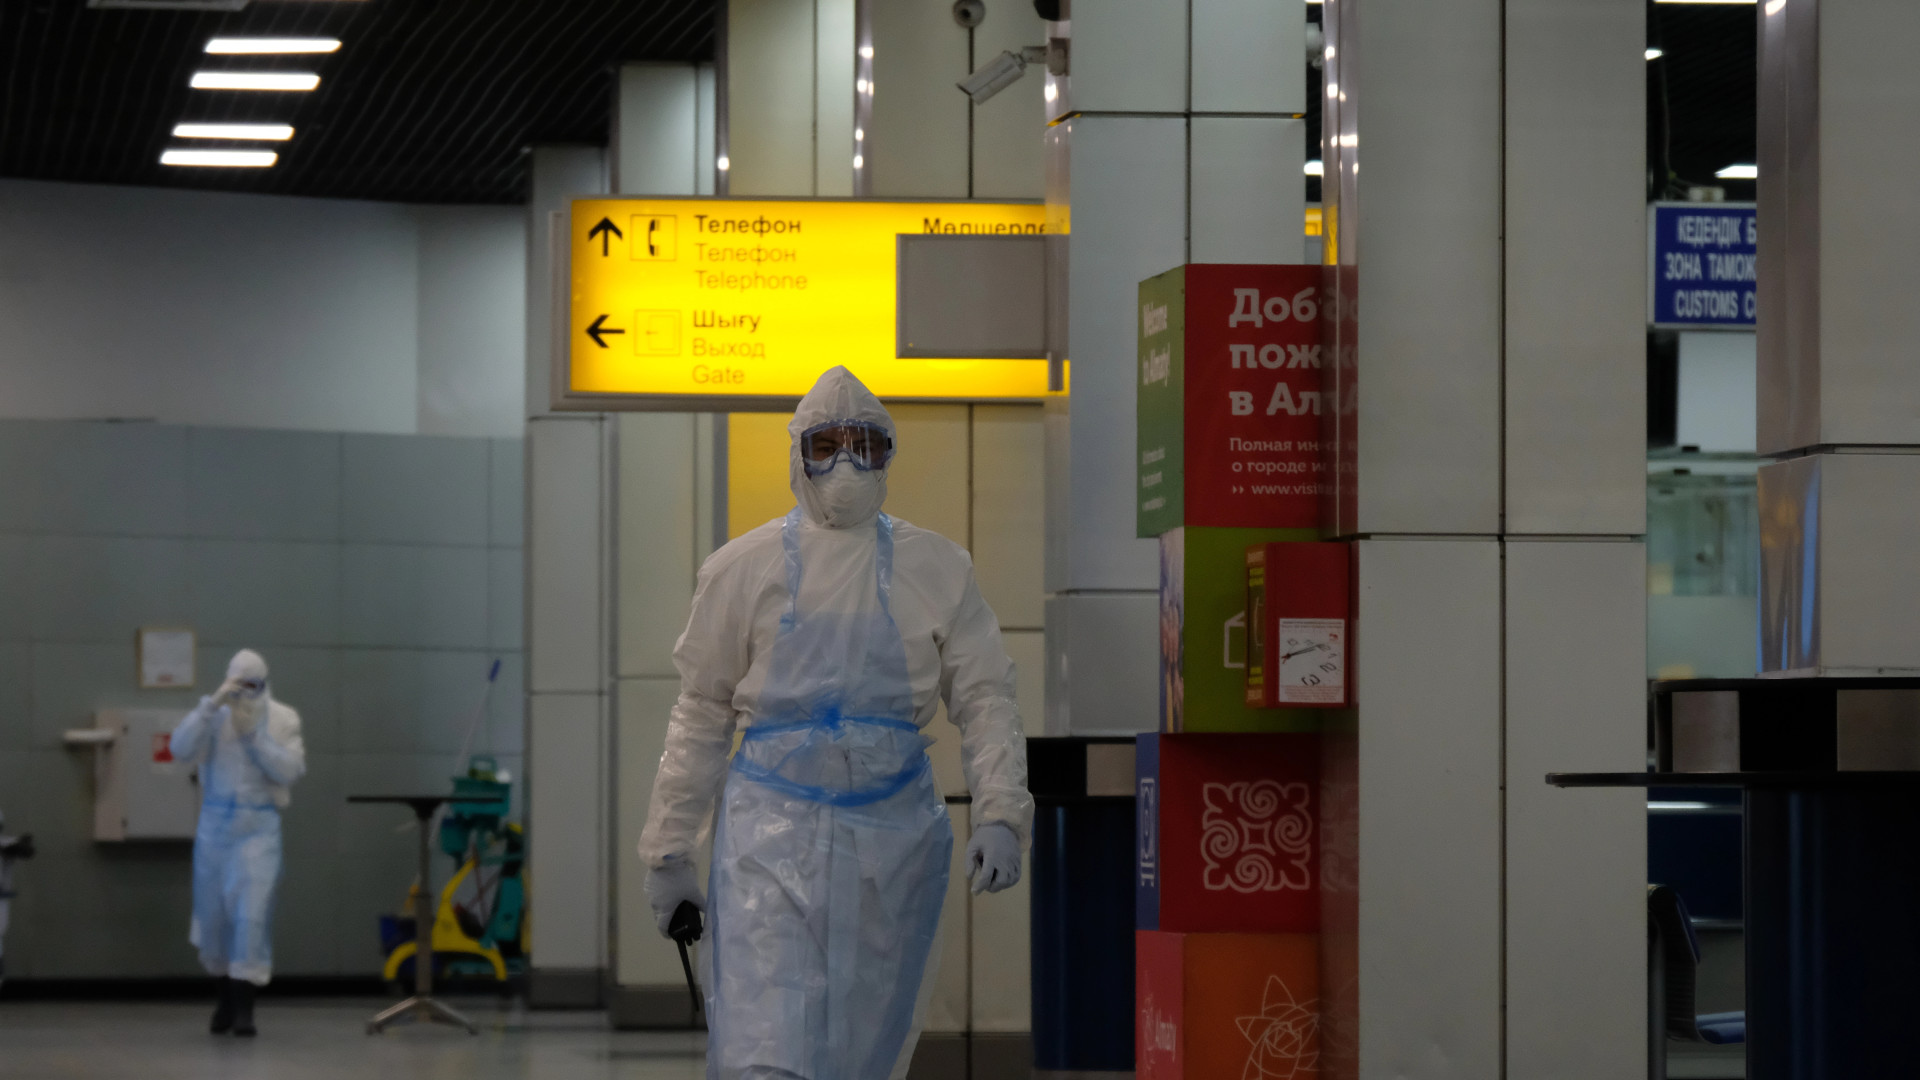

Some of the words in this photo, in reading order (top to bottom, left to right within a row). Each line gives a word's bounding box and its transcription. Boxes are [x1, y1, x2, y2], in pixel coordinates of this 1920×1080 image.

[694, 214, 801, 237] Телефон
[694, 243, 797, 265] Телефон
[1665, 252, 1702, 280] ЗОНА
[694, 270, 808, 292] Telephone
[1228, 287, 1321, 328] Доб
[1675, 289, 1739, 318] CUSTOMS
[693, 310, 762, 333] Шығу
[692, 338, 766, 360] Выход
[692, 364, 745, 384] Gate
[1228, 391, 1254, 416] в
[1229, 437, 1292, 452] Полная
[1231, 461, 1243, 473] о
[1247, 461, 1307, 475] городе
